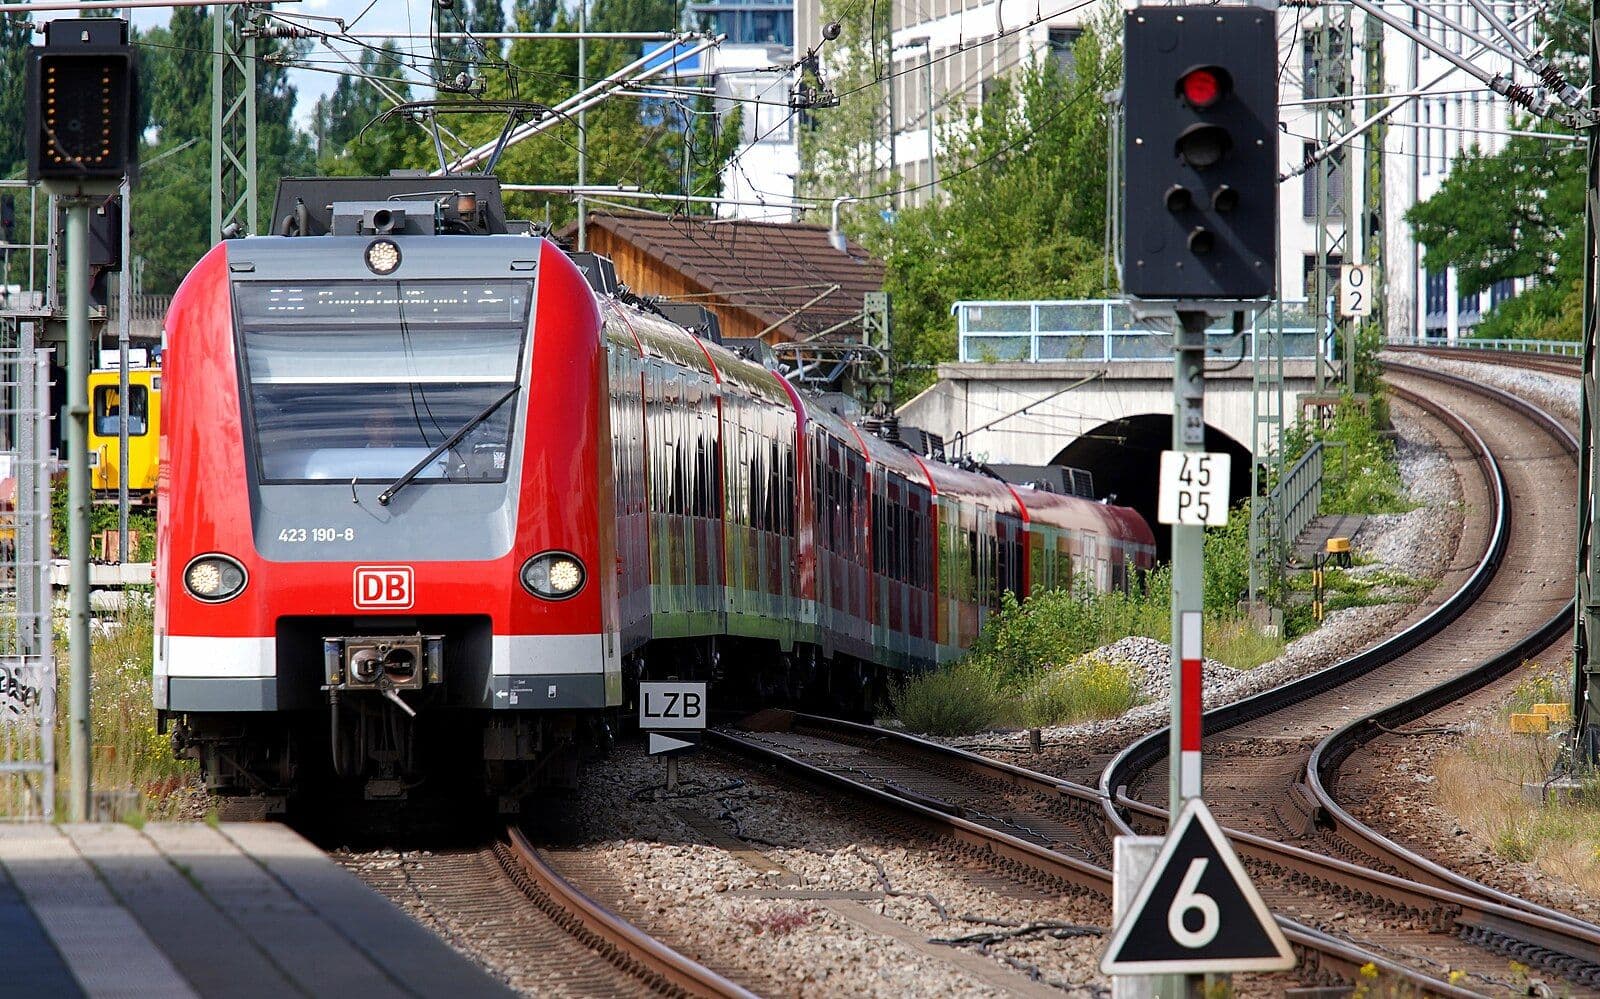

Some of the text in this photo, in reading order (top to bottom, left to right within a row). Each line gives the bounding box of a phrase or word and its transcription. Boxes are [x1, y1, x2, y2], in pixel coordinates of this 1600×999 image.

[1350, 292, 1362, 310] 2
[1179, 454, 1211, 486] 45
[1178, 491, 1210, 520] P5
[278, 528, 354, 541] 423 190-8
[363, 574, 406, 600] DB
[644, 692, 701, 718] LZB
[1167, 858, 1220, 948] 6
